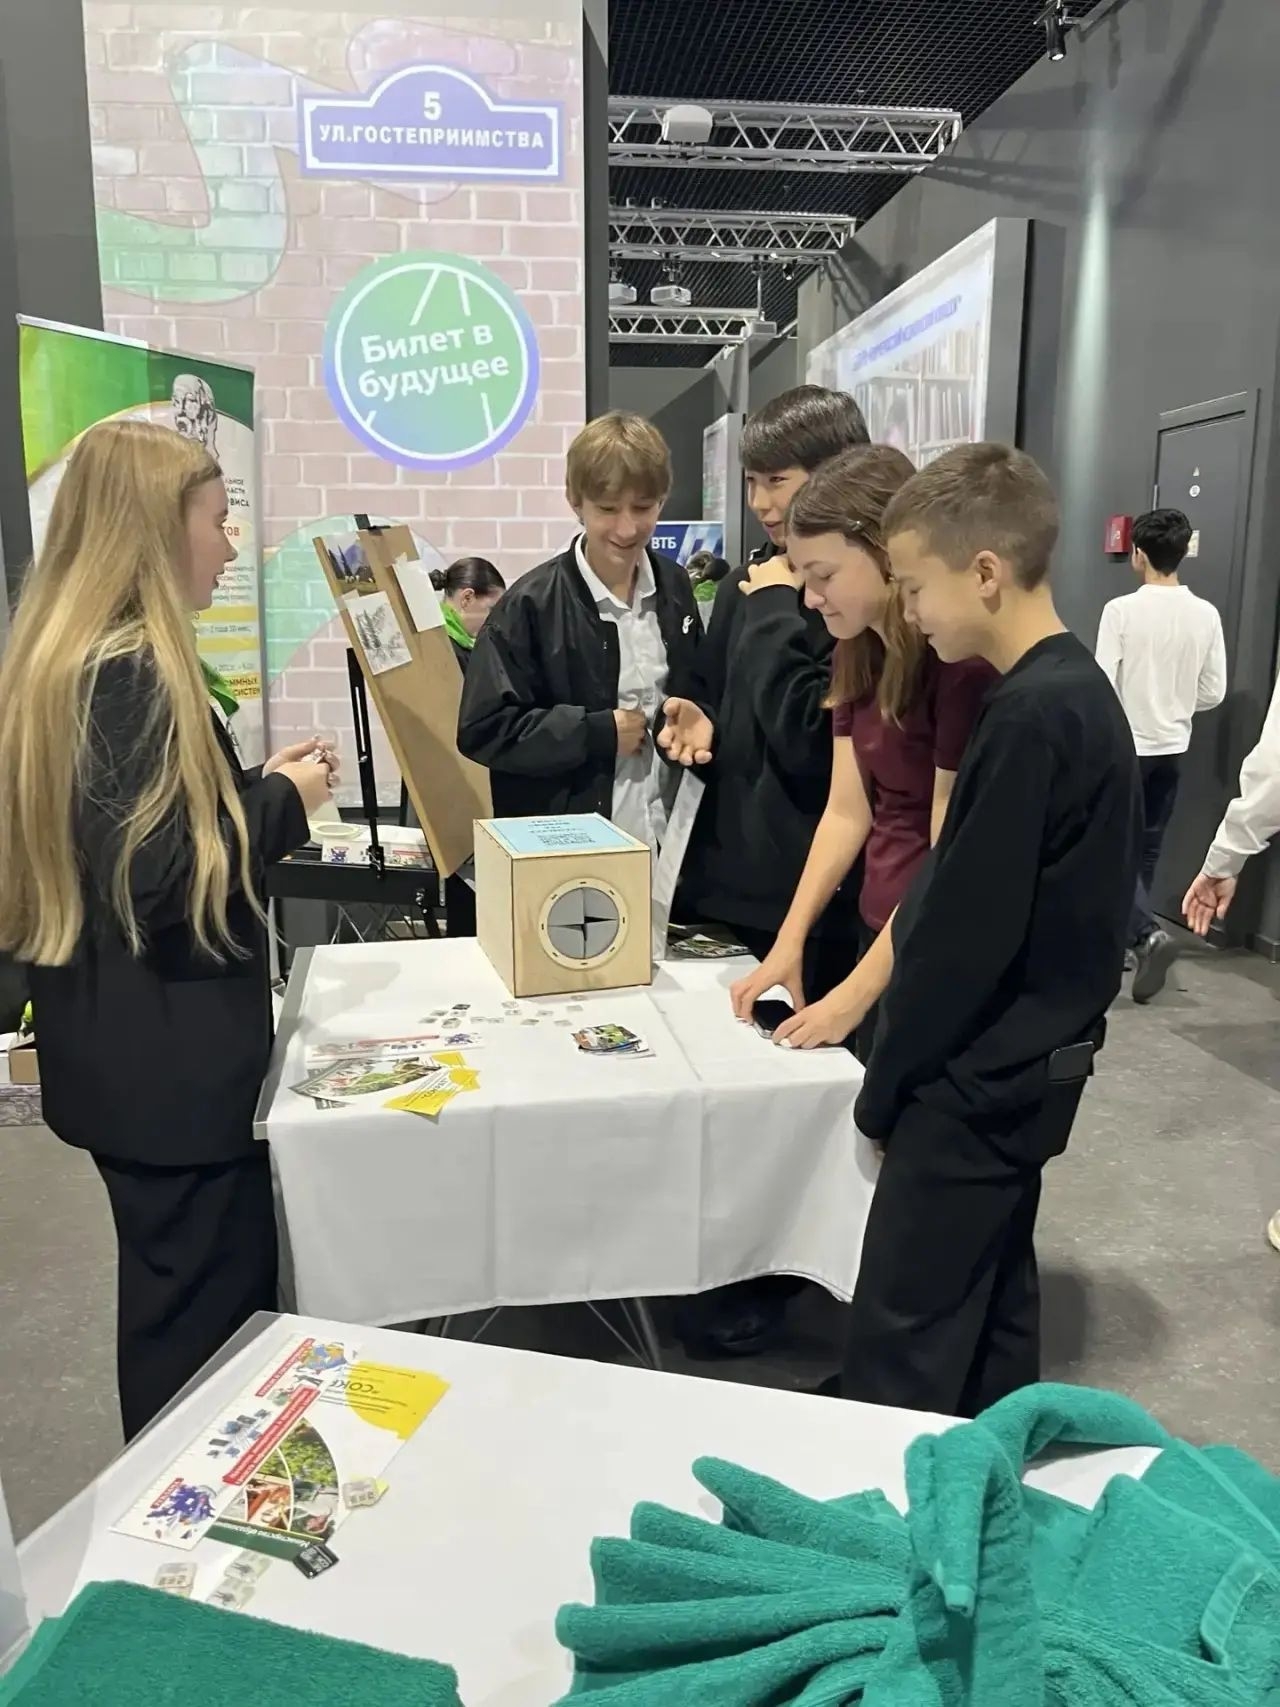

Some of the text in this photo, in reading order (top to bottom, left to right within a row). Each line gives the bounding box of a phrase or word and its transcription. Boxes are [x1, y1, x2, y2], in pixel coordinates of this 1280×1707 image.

[423, 91, 443, 121] 5
[319, 124, 545, 149] УЛ.ГОСТЕПРИИМСТВА
[360, 324, 494, 364] Билет в
[358, 353, 510, 402] будущее
[651, 536, 677, 549] ВТБ
